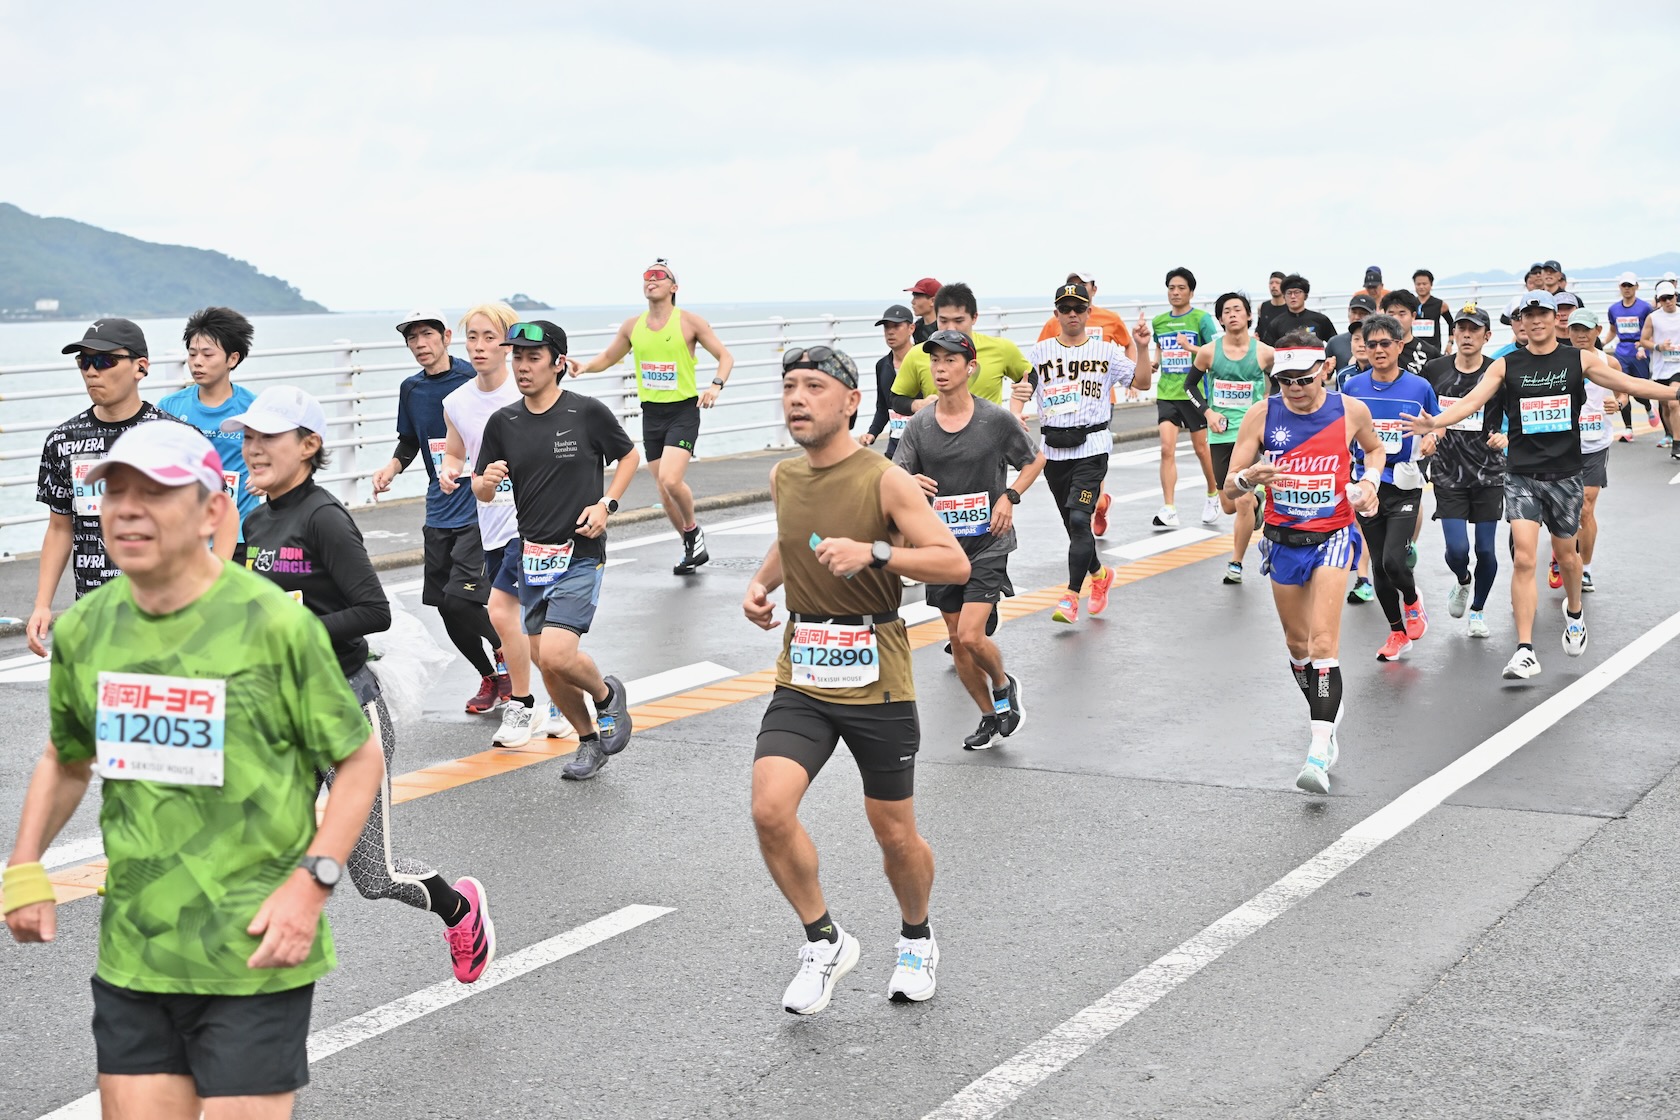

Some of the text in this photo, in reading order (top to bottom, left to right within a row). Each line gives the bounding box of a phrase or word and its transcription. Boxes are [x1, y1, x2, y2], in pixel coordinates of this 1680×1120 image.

[648, 371, 675, 381] 10352
[1038, 358, 1109, 383] Tigers
[1081, 380, 1102, 400] 1985
[1221, 390, 1251, 399] 13509
[1048, 393, 1078, 406] 12361
[1522, 398, 1569, 410] 福岡トヨタ
[1533, 408, 1567, 421] 11321
[1579, 414, 1602, 423] トヨタ
[1579, 422, 1602, 431] 3143
[217, 431, 241, 439] 2024
[1377, 431, 1399, 442] 374
[76, 487, 84, 497] B
[1274, 490, 1331, 504] C 11905
[934, 496, 987, 511] 福岡トヨタ
[943, 507, 988, 524] 13485
[1287, 507, 1318, 517] Salonpas
[280, 547, 304, 560] RUN
[272, 560, 312, 573] CIRCLE
[528, 555, 568, 571] 11565
[794, 628, 871, 647] 福岡トヨタ
[792, 647, 874, 667] D 12890
[103, 683, 215, 714] 福岡トヨタ
[99, 713, 213, 749] C 12053
[167, 763, 195, 775] HOUSE
